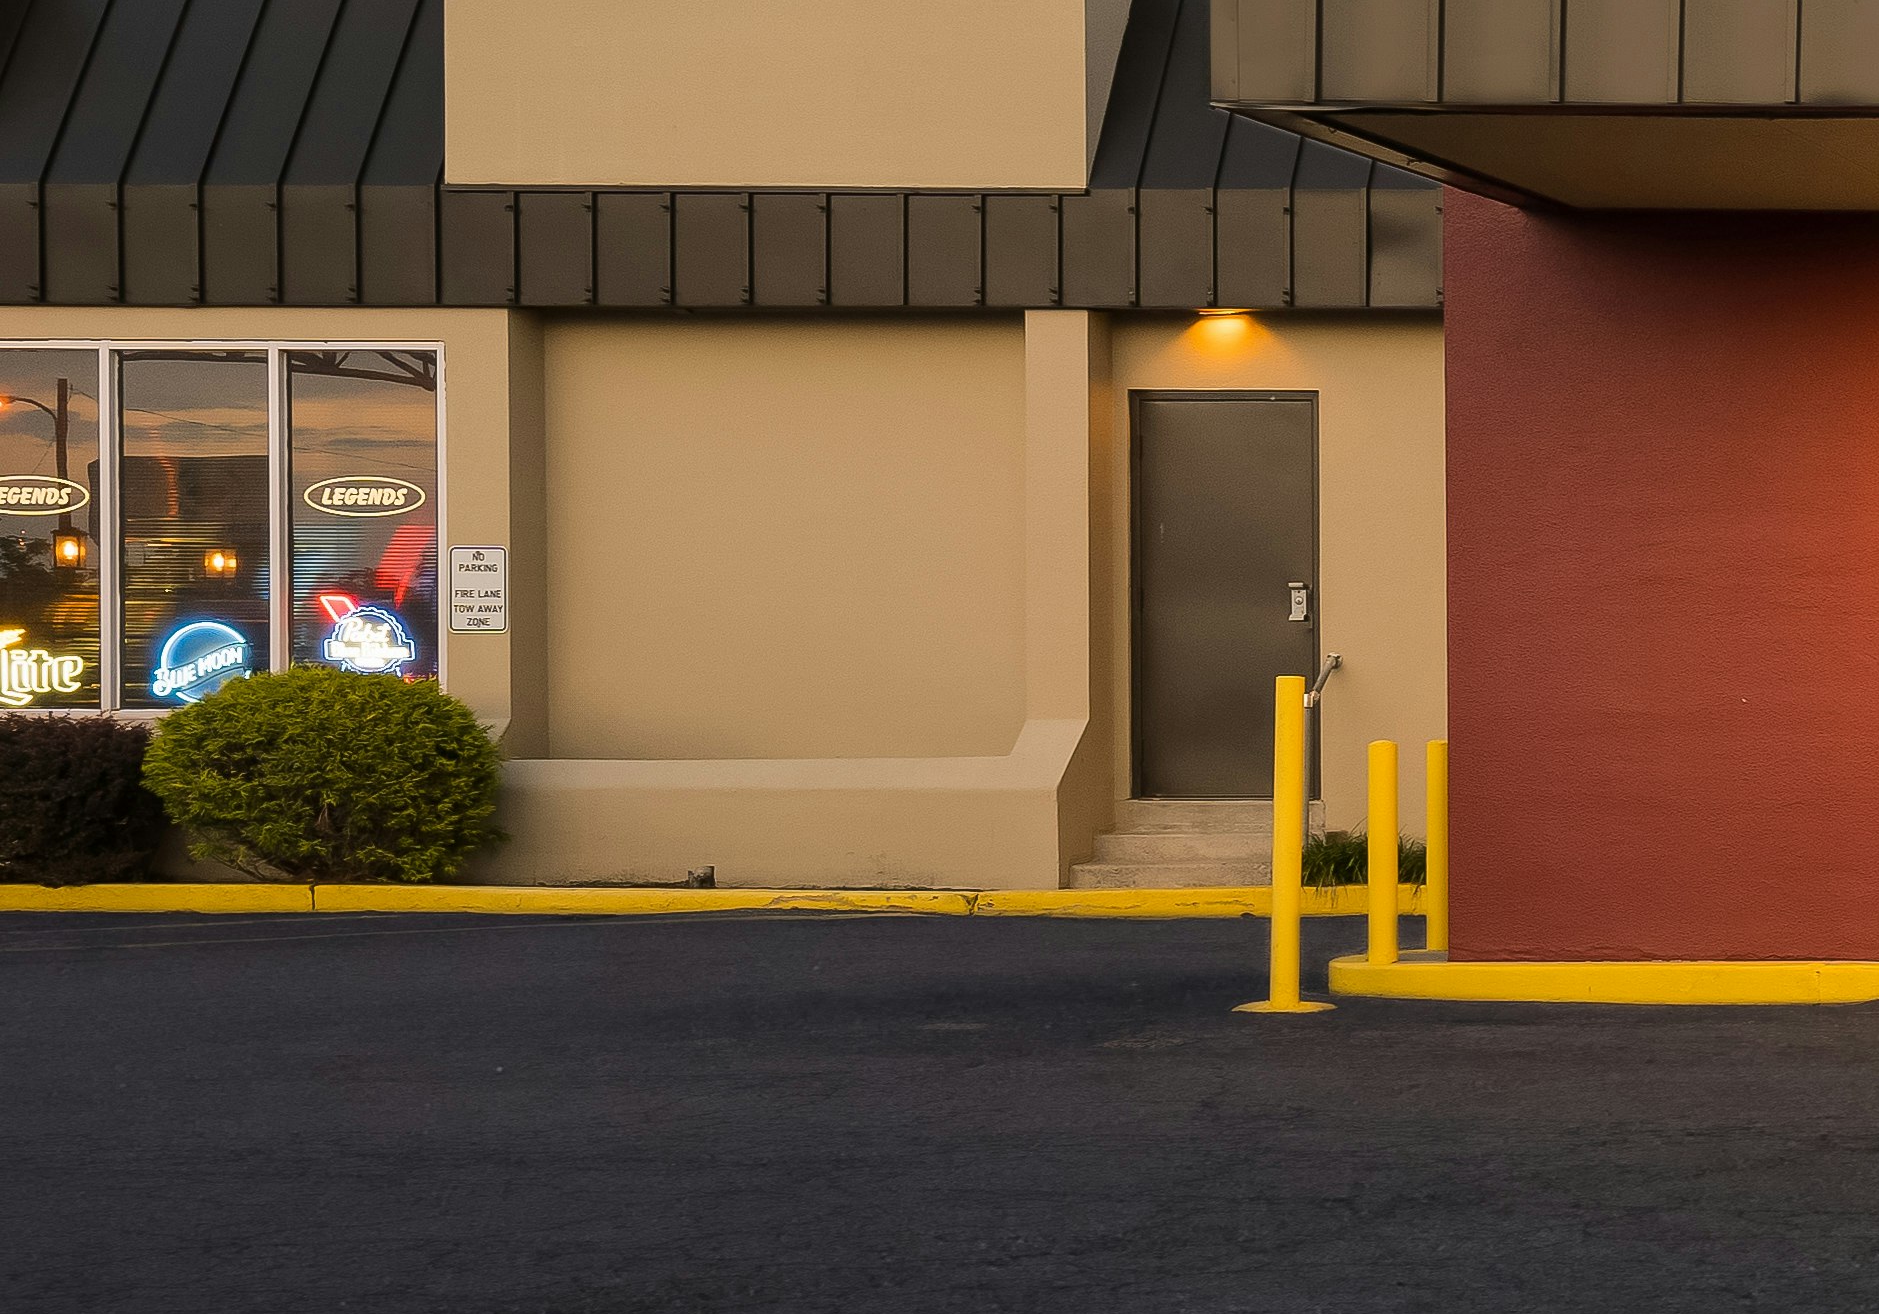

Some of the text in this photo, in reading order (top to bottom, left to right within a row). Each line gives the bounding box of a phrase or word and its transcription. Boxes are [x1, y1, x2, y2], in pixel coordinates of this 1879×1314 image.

[0, 486, 72, 505] EGENDS
[321, 487, 408, 506] LEGENDS
[472, 552, 485, 561] NO
[458, 564, 498, 572] PARKING
[455, 589, 501, 598] FIRE LANE
[453, 604, 503, 613] TOW AWAY
[466, 617, 490, 627] ZONE
[197, 646, 243, 677] MOON
